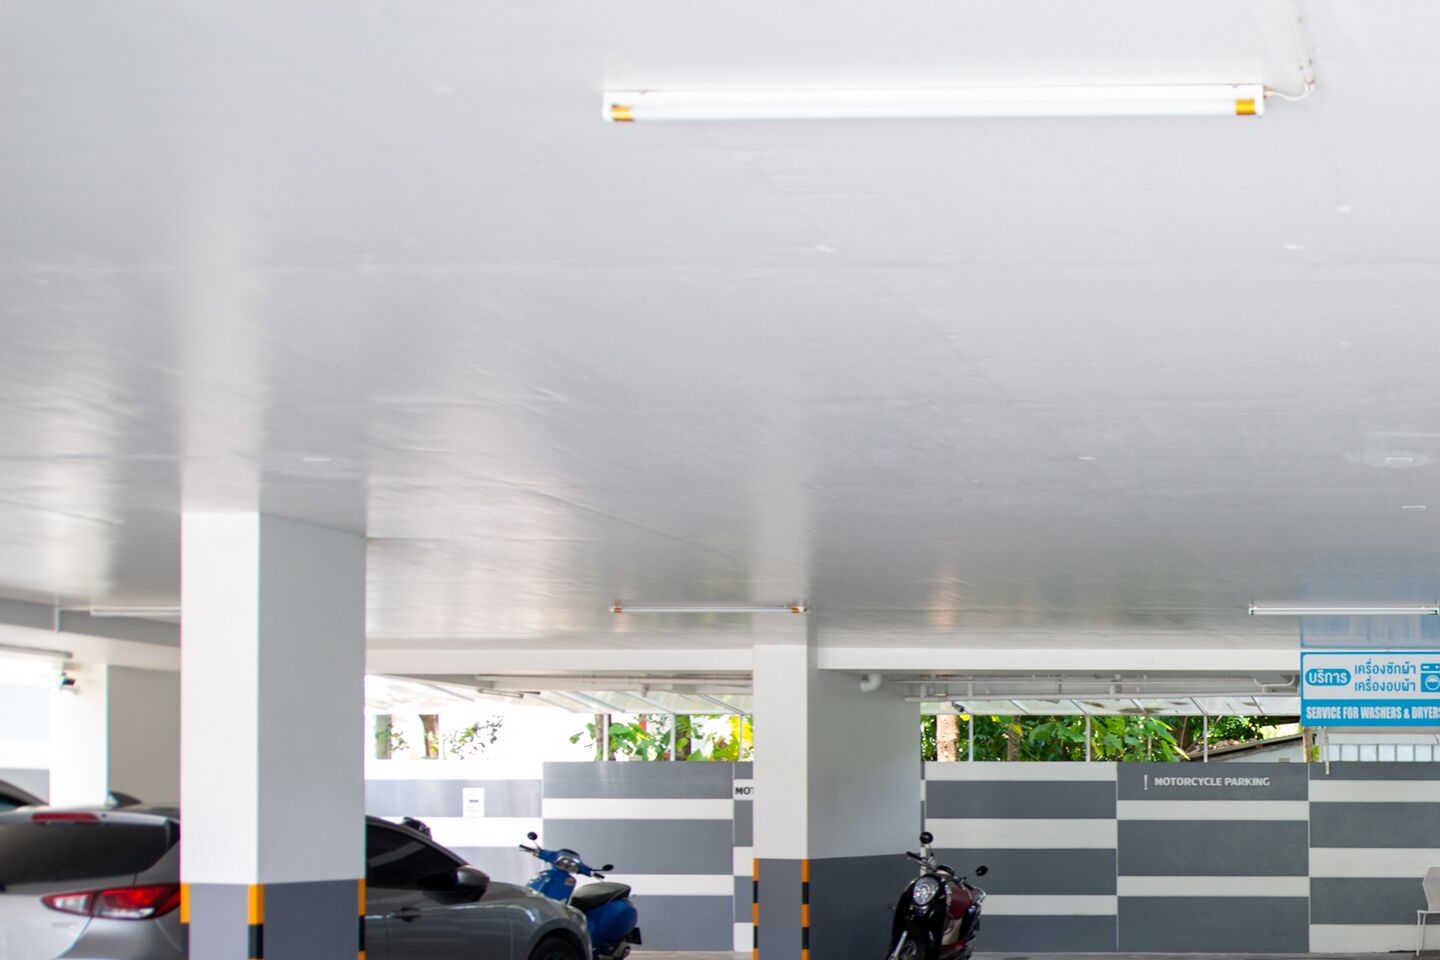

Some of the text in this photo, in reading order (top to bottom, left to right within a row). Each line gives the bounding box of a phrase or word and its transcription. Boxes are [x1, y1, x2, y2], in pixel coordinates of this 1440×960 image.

[1354, 658, 1416, 675] เครื่องซักผ้า
[1308, 669, 1348, 684] บริการ
[1354, 675, 1416, 692] เครื่องอบผ้า
[1306, 706, 1341, 720] SERVICE
[1343, 706, 1359, 720] FOR
[1361, 706, 1402, 720] WASHERS
[1403, 708, 1410, 719] &
[1154, 777, 1222, 786] MOTORCYCLE
[1224, 777, 1270, 786] PARKING
